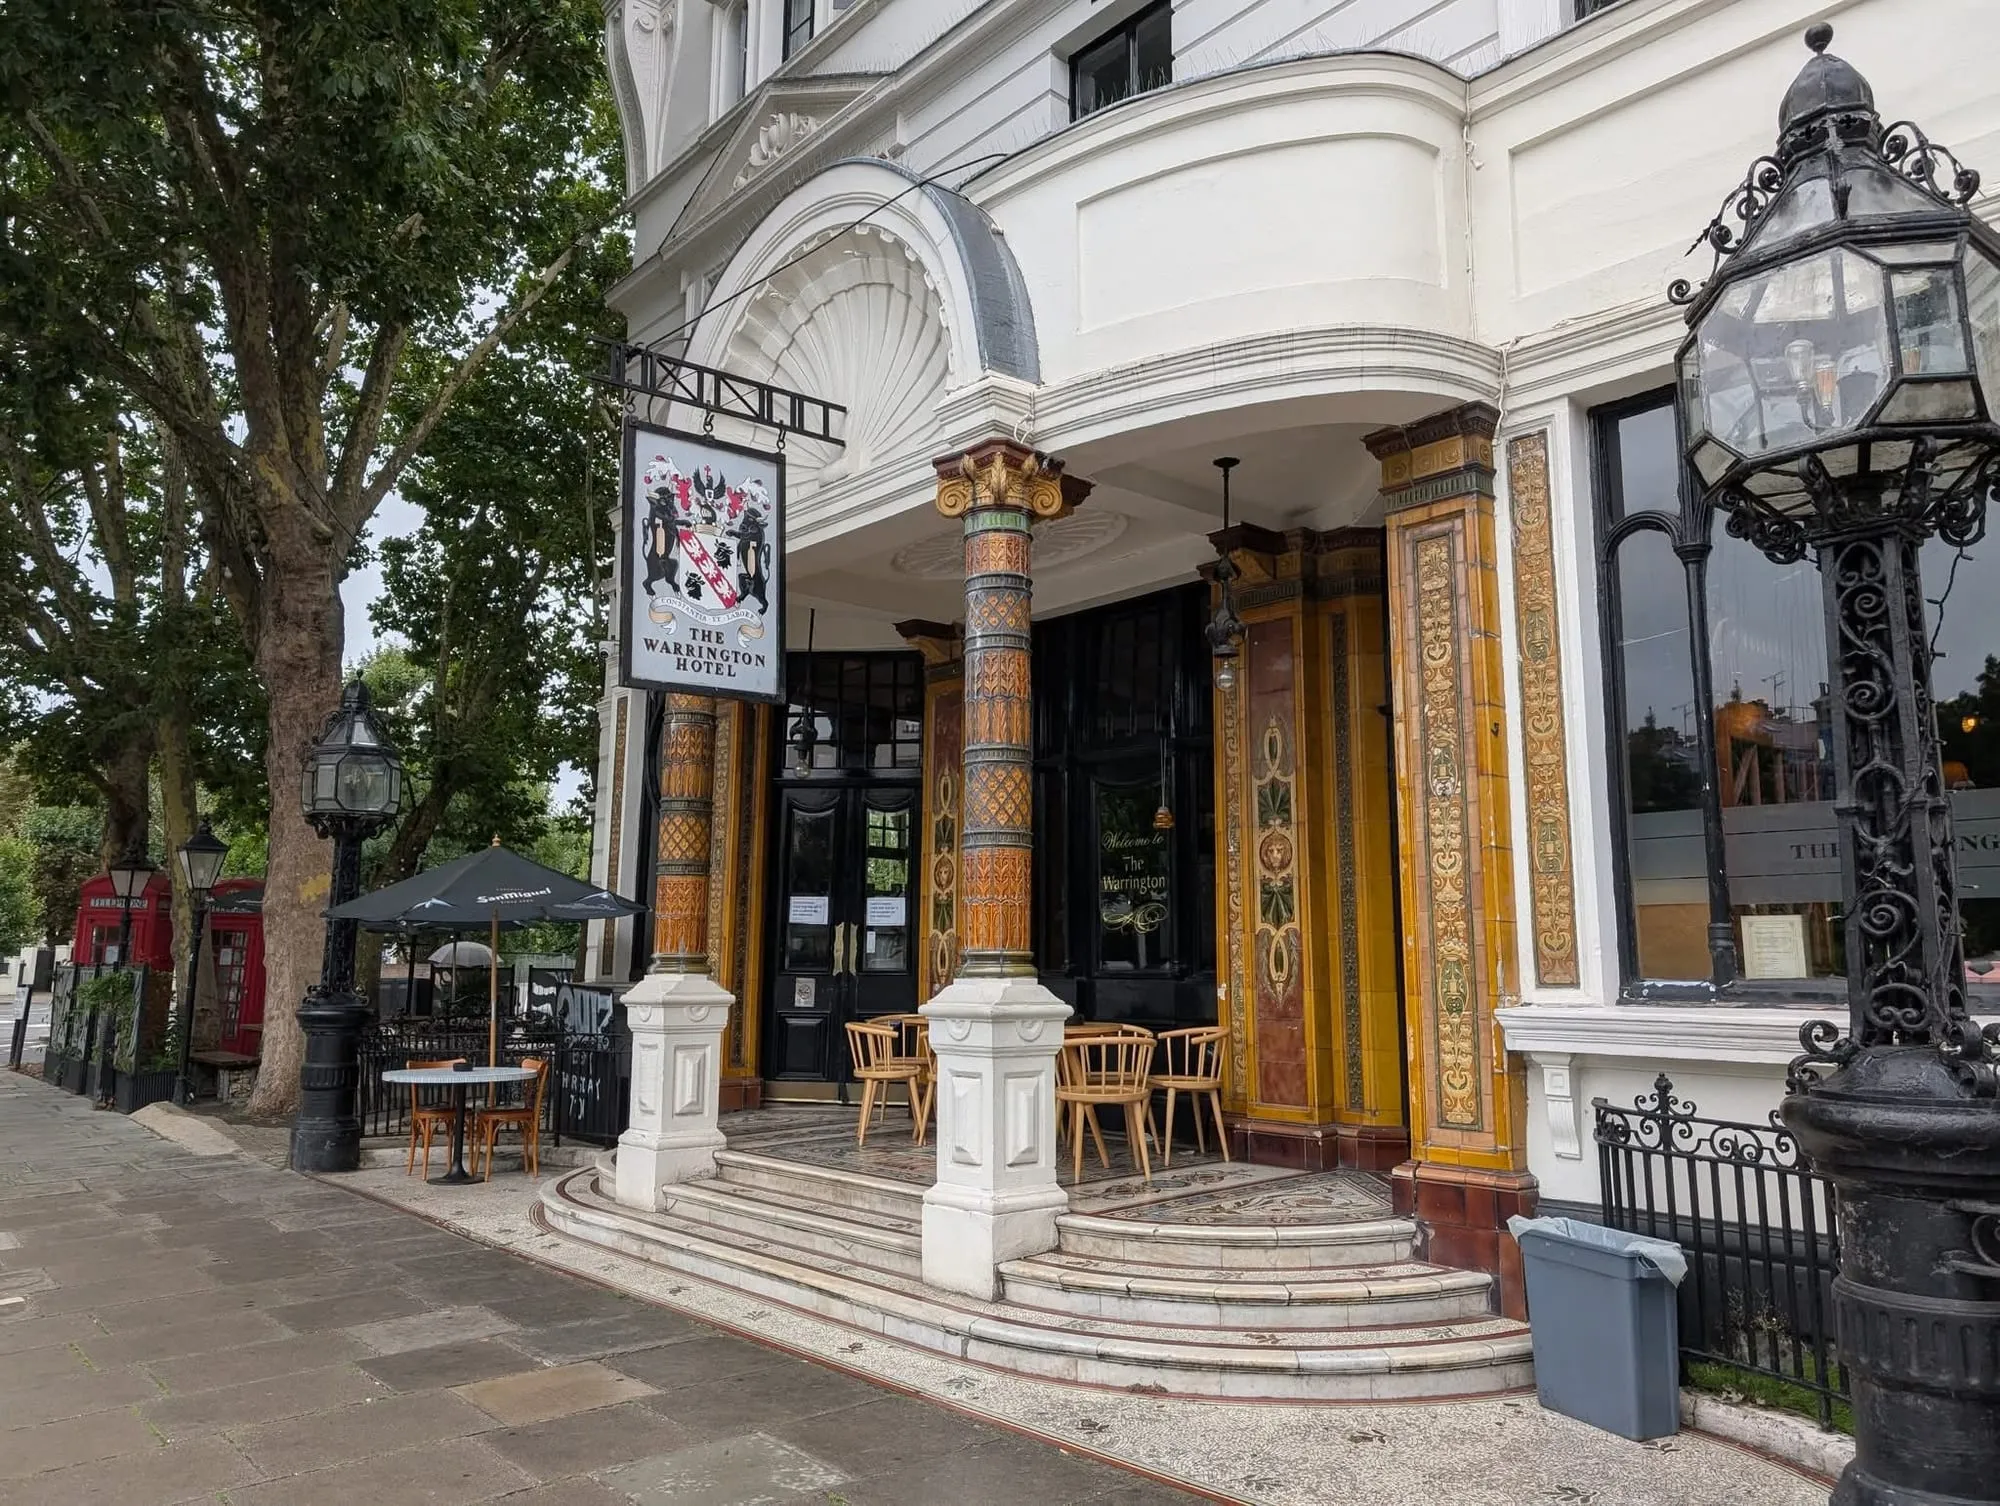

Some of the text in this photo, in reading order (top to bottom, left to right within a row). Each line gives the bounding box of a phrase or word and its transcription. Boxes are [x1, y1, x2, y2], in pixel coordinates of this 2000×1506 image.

[661, 598, 707, 622] CONSTANTIA
[689, 627, 725, 645] THE
[643, 638, 765, 667] WARRINGTON
[676, 657, 736, 677] HOTEL
[1102, 831, 1150, 851] Welcome
[1121, 855, 1145, 872] The
[1103, 875, 1166, 895] Warrington
